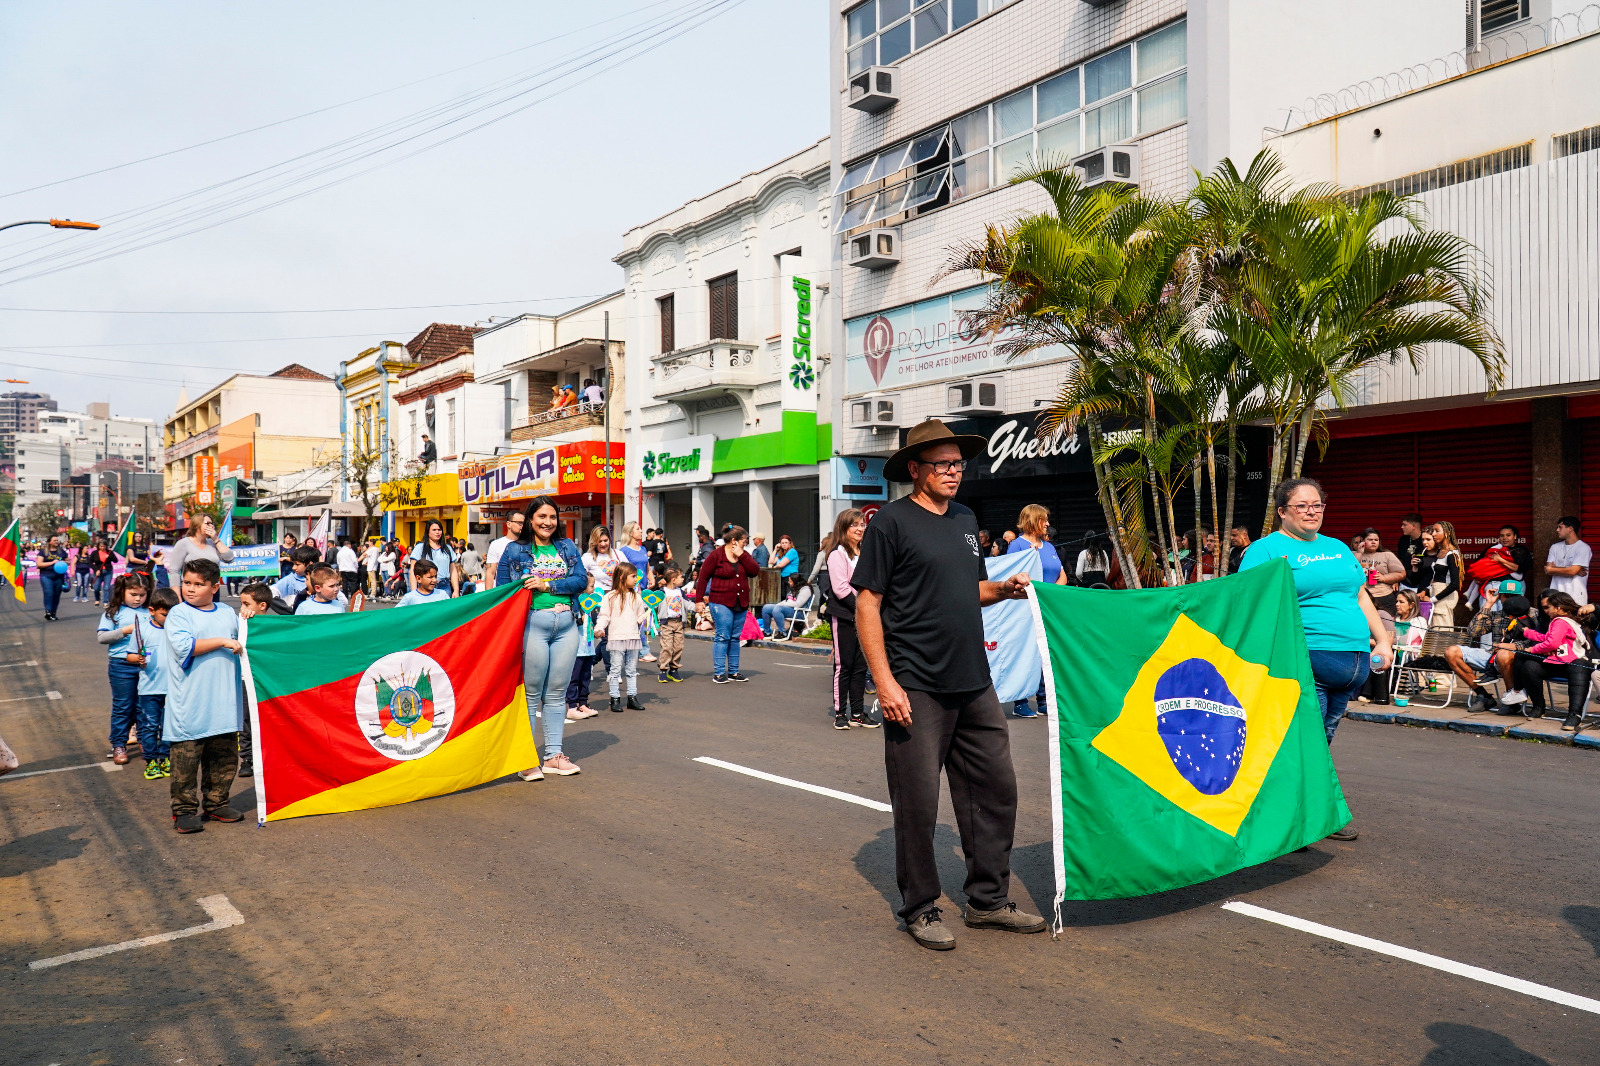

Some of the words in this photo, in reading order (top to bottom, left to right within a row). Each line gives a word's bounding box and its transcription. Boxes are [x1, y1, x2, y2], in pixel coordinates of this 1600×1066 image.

[793, 275, 811, 361] Sicredi
[898, 366, 904, 375] O
[905, 361, 934, 373] MELHOR
[935, 350, 988, 368] ATENDIMENTO
[458, 463, 487, 479] LOJÃO
[657, 447, 701, 475] Sicredi
[464, 449, 555, 502] UTILAR
[1246, 471, 1263, 480] 2555
[1157, 700, 1181, 713] ORDEM
[1185, 700, 1191, 708] E
[1194, 700, 1243, 717] PROGRESSO
